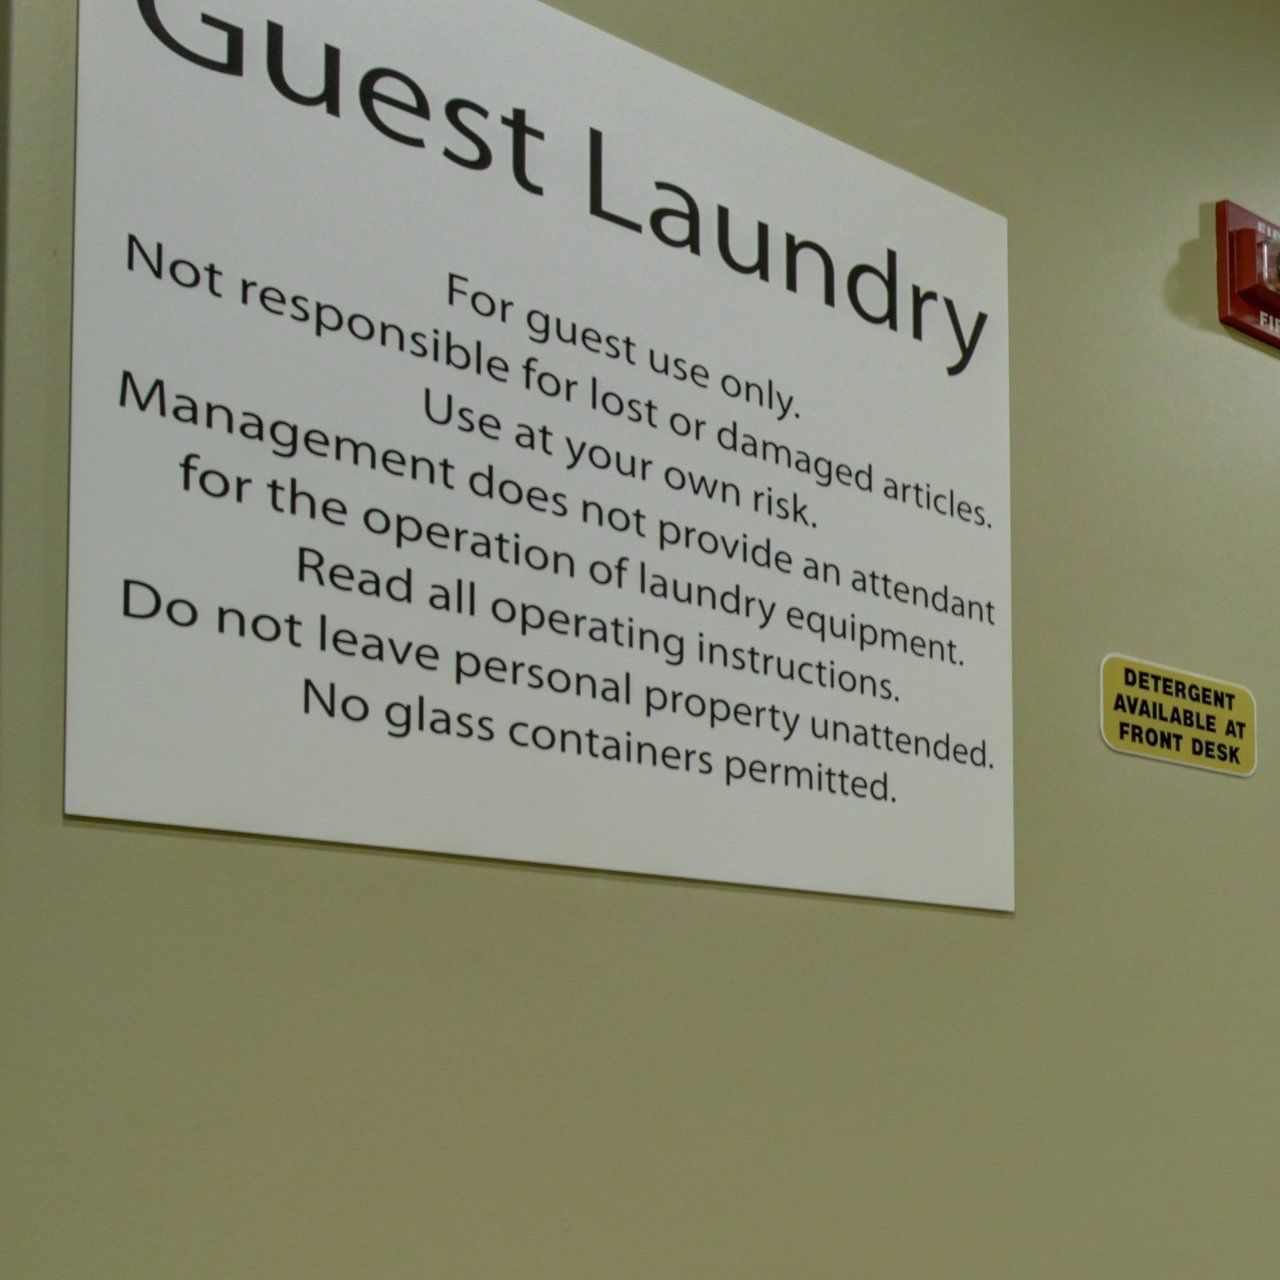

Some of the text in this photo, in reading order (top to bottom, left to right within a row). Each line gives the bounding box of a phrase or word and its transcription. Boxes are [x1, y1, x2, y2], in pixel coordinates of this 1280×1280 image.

[589, 127, 988, 377] Laundry
[127, 233, 993, 526] Not responsible for lost or damaged articles.
[448, 272, 800, 421] For guest use only.
[119, 369, 995, 625] Management does not provide an attendant
[424, 387, 817, 528] Use at your own risk.
[179, 453, 965, 665] for the operation of laundry equipment.
[298, 546, 900, 700] Read all operating instructions.
[122, 578, 994, 768] Do not leave personal property unattended.
[303, 678, 896, 802] No glass containers permitted.
[1113, 693, 1246, 739] AVAILABLE AT
[1119, 721, 1241, 764] FRONT DESK
[1124, 667, 1236, 710] DETERGENT
